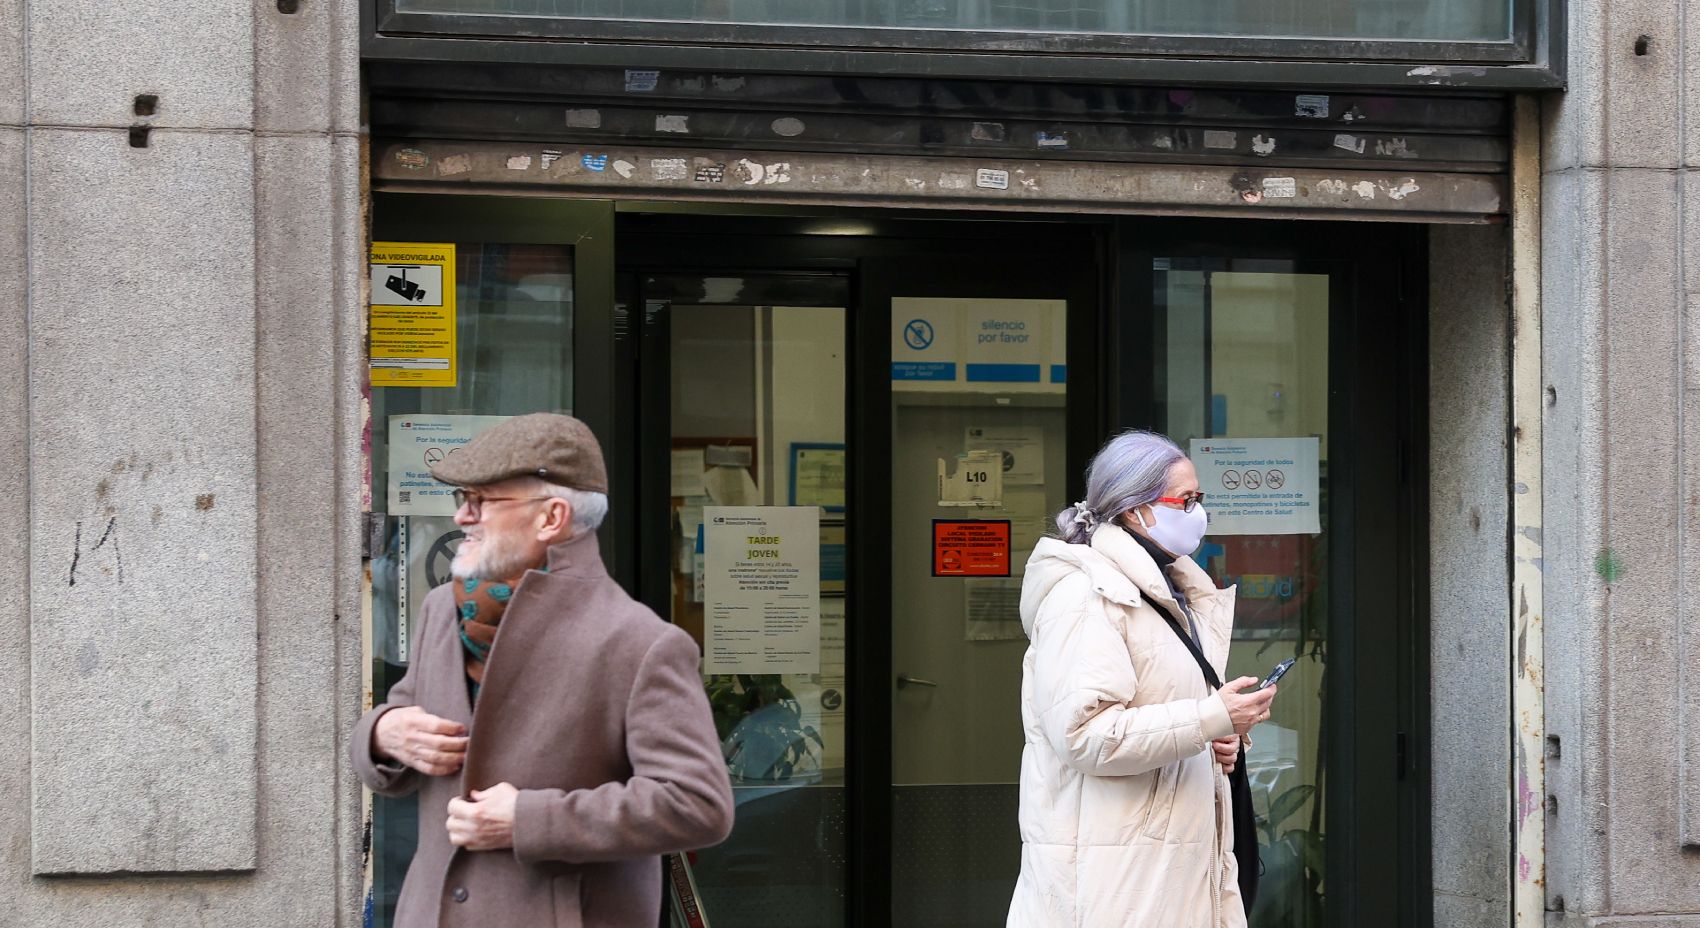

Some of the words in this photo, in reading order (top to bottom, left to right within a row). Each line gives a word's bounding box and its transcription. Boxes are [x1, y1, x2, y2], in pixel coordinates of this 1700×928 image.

[388, 254, 446, 262] VIDEOVIGILADA
[982, 320, 1025, 330] silencio
[978, 333, 996, 344] por
[1000, 332, 1030, 343] favor
[966, 472, 987, 482] L10
[747, 550, 778, 559] JOVEN
